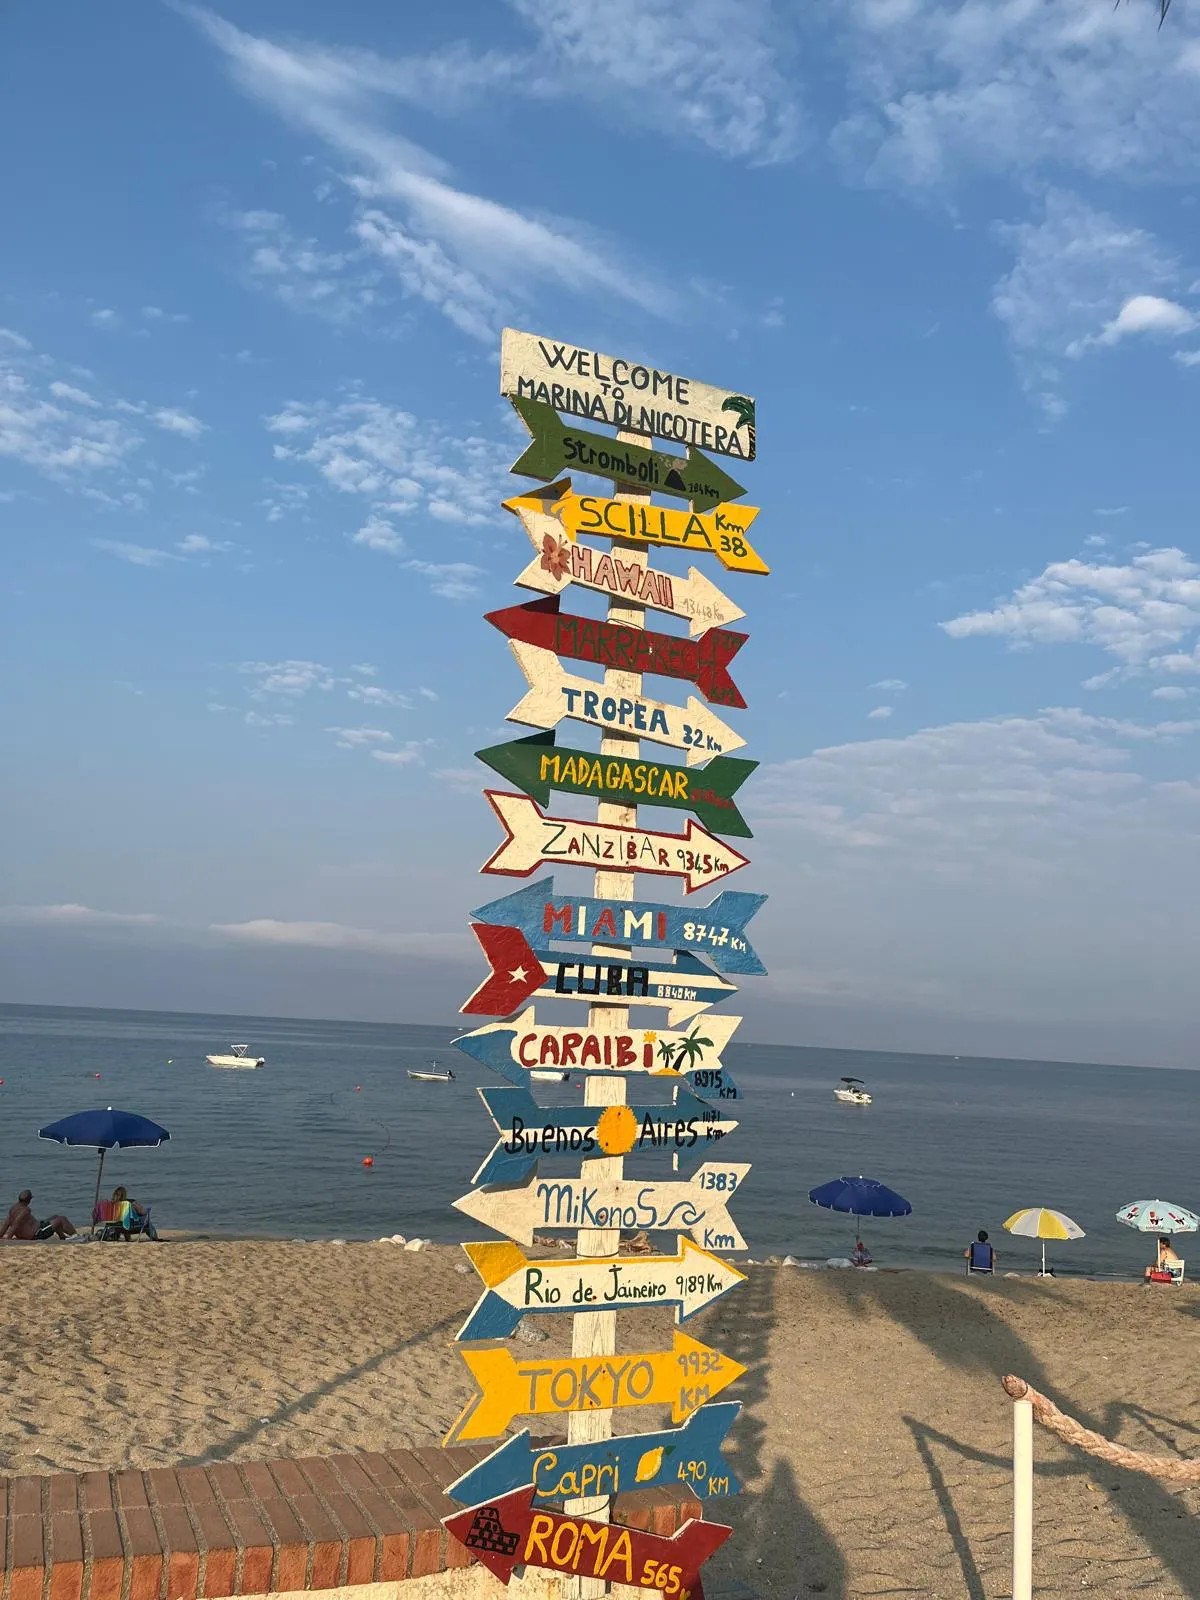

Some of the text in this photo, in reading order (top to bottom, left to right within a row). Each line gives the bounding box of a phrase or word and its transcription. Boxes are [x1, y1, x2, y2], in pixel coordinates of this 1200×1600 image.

[538, 341, 690, 405] WELCOME
[600, 382, 625, 400] TO
[517, 375, 744, 457] MARINA DI NICOTERA
[562, 436, 659, 485] Stromboli
[579, 498, 713, 548] SCILLA
[715, 513, 745, 534] Km
[720, 535, 748, 558] 38
[571, 545, 675, 609] HAWAII
[555, 616, 717, 688] MARRAKECH
[561, 686, 670, 735] TROPEA
[682, 724, 705, 749] 32
[540, 753, 689, 800] MADAGASCAR
[540, 822, 671, 868] ZANZIBAR
[543, 902, 667, 941] MIAMI
[683, 922, 730, 947] 8747
[555, 962, 649, 997] CUBA
[719, 1087, 737, 1099] KM
[504, 1112, 700, 1155] Buenos Aires
[699, 1172, 738, 1191] 1383
[704, 1228, 736, 1249] Km
[524, 1267, 562, 1305] Rio
[572, 1278, 594, 1304] de
[676, 1275, 705, 1296] 9189
[518, 1359, 654, 1411] TOKYO
[677, 1351, 724, 1377] 9932
[680, 1383, 710, 1412] KM
[533, 1451, 620, 1498] Capri
[677, 1460, 707, 1481] 490
[708, 1476, 729, 1496] KM
[523, 1514, 683, 1594] ROMA 565
